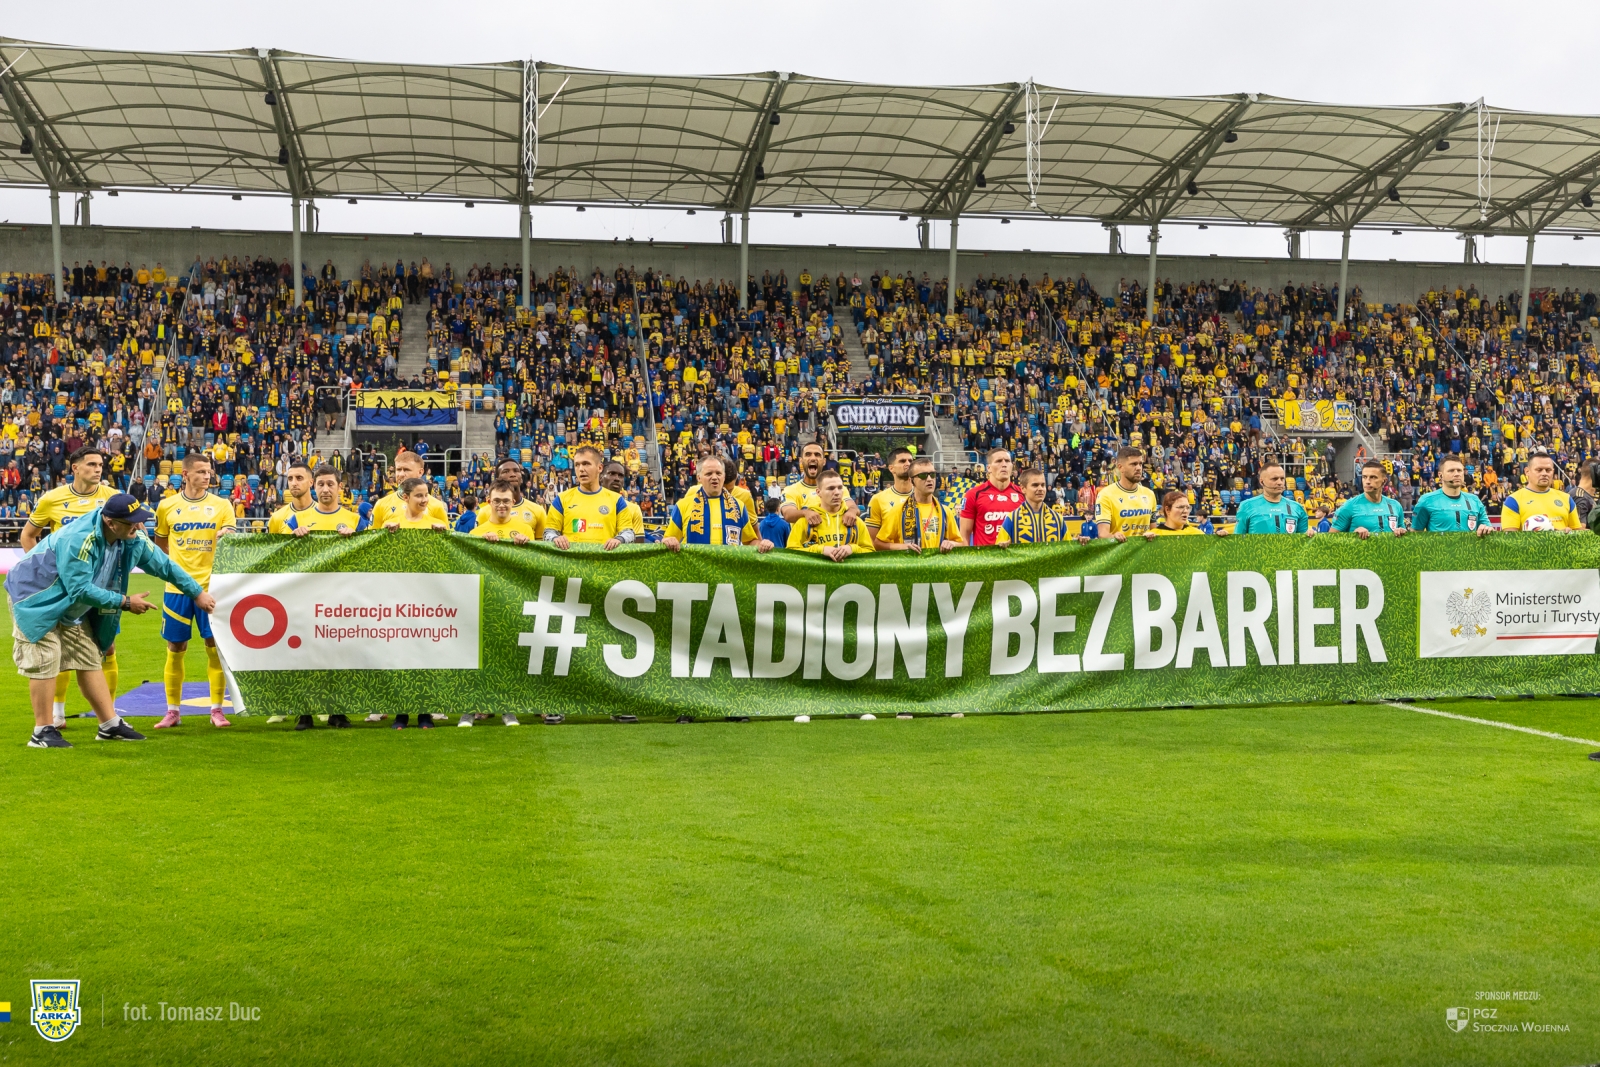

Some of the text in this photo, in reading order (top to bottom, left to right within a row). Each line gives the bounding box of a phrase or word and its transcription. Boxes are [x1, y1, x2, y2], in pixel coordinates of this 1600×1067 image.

[836, 404, 920, 425] GNIEWINO
[173, 522, 216, 532] GDYNIA
[186, 538, 213, 546] Energa
[818, 533, 844, 544] RUGB
[1496, 592, 1582, 606] Ministerstwo
[314, 603, 458, 621] Federacja Kibiców
[1495, 610, 1540, 626] Sportu
[1543, 610, 1547, 623] i
[989, 574, 1125, 676] BEZ
[1131, 568, 1389, 670] BARIER
[314, 624, 458, 642] Niepełnosprawnych
